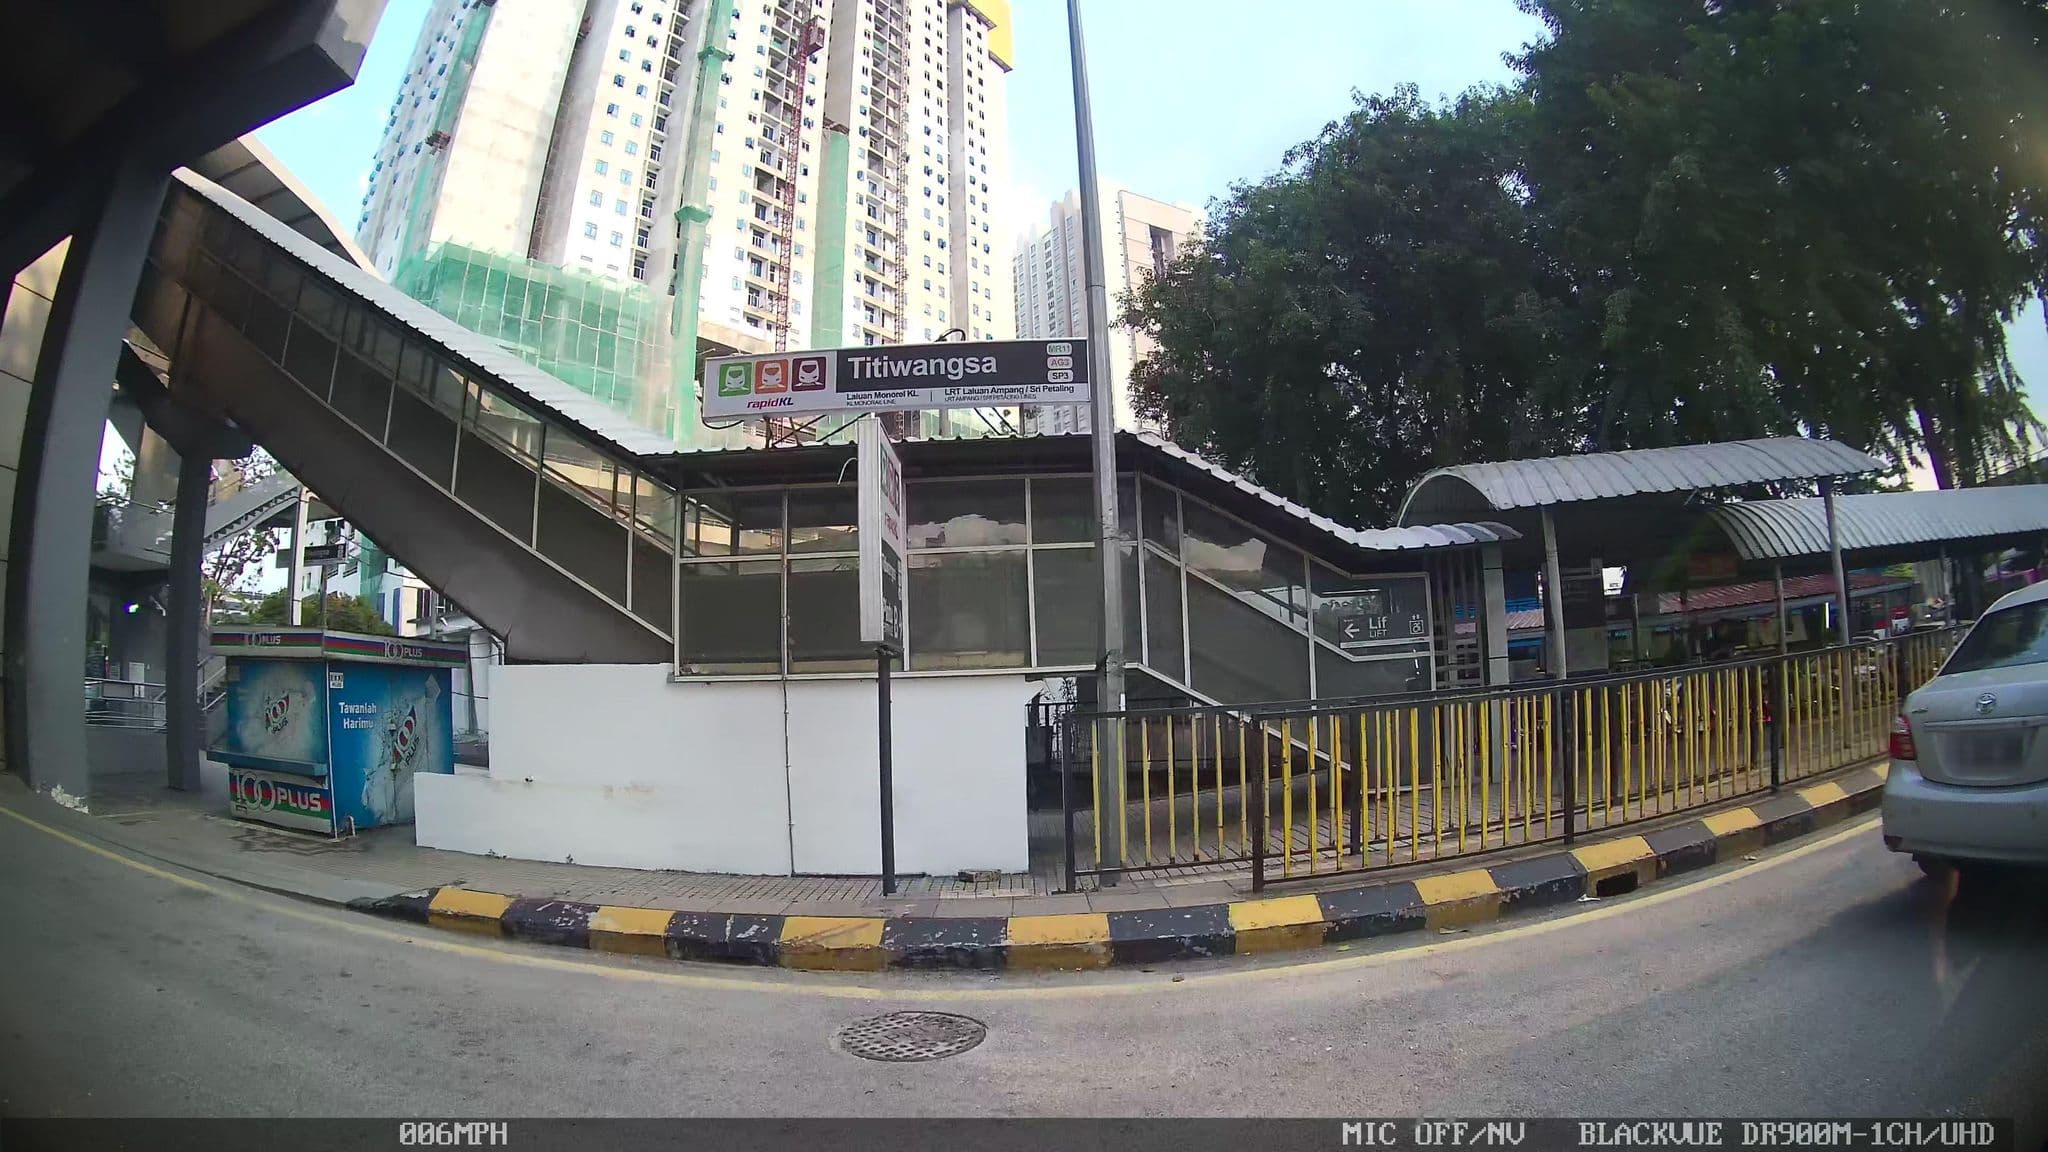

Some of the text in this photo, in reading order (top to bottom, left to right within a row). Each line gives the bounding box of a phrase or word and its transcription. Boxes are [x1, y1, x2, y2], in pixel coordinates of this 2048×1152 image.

[847, 354, 998, 381] Titiwangsa
[1050, 358, 1070, 366] AG3
[1052, 371, 1069, 380] SP3
[847, 392, 872, 400] Laluan
[907, 389, 919, 397] KL
[962, 387, 989, 395] Laluan
[991, 386, 1024, 395] Ampang
[1043, 384, 1075, 393] Petaling
[747, 396, 794, 410] rapidKL
[1369, 616, 1387, 629] Lif
[1369, 629, 1387, 638] LIFT
[338, 702, 377, 714] Tawanlah
[343, 718, 374, 729] Harimu
